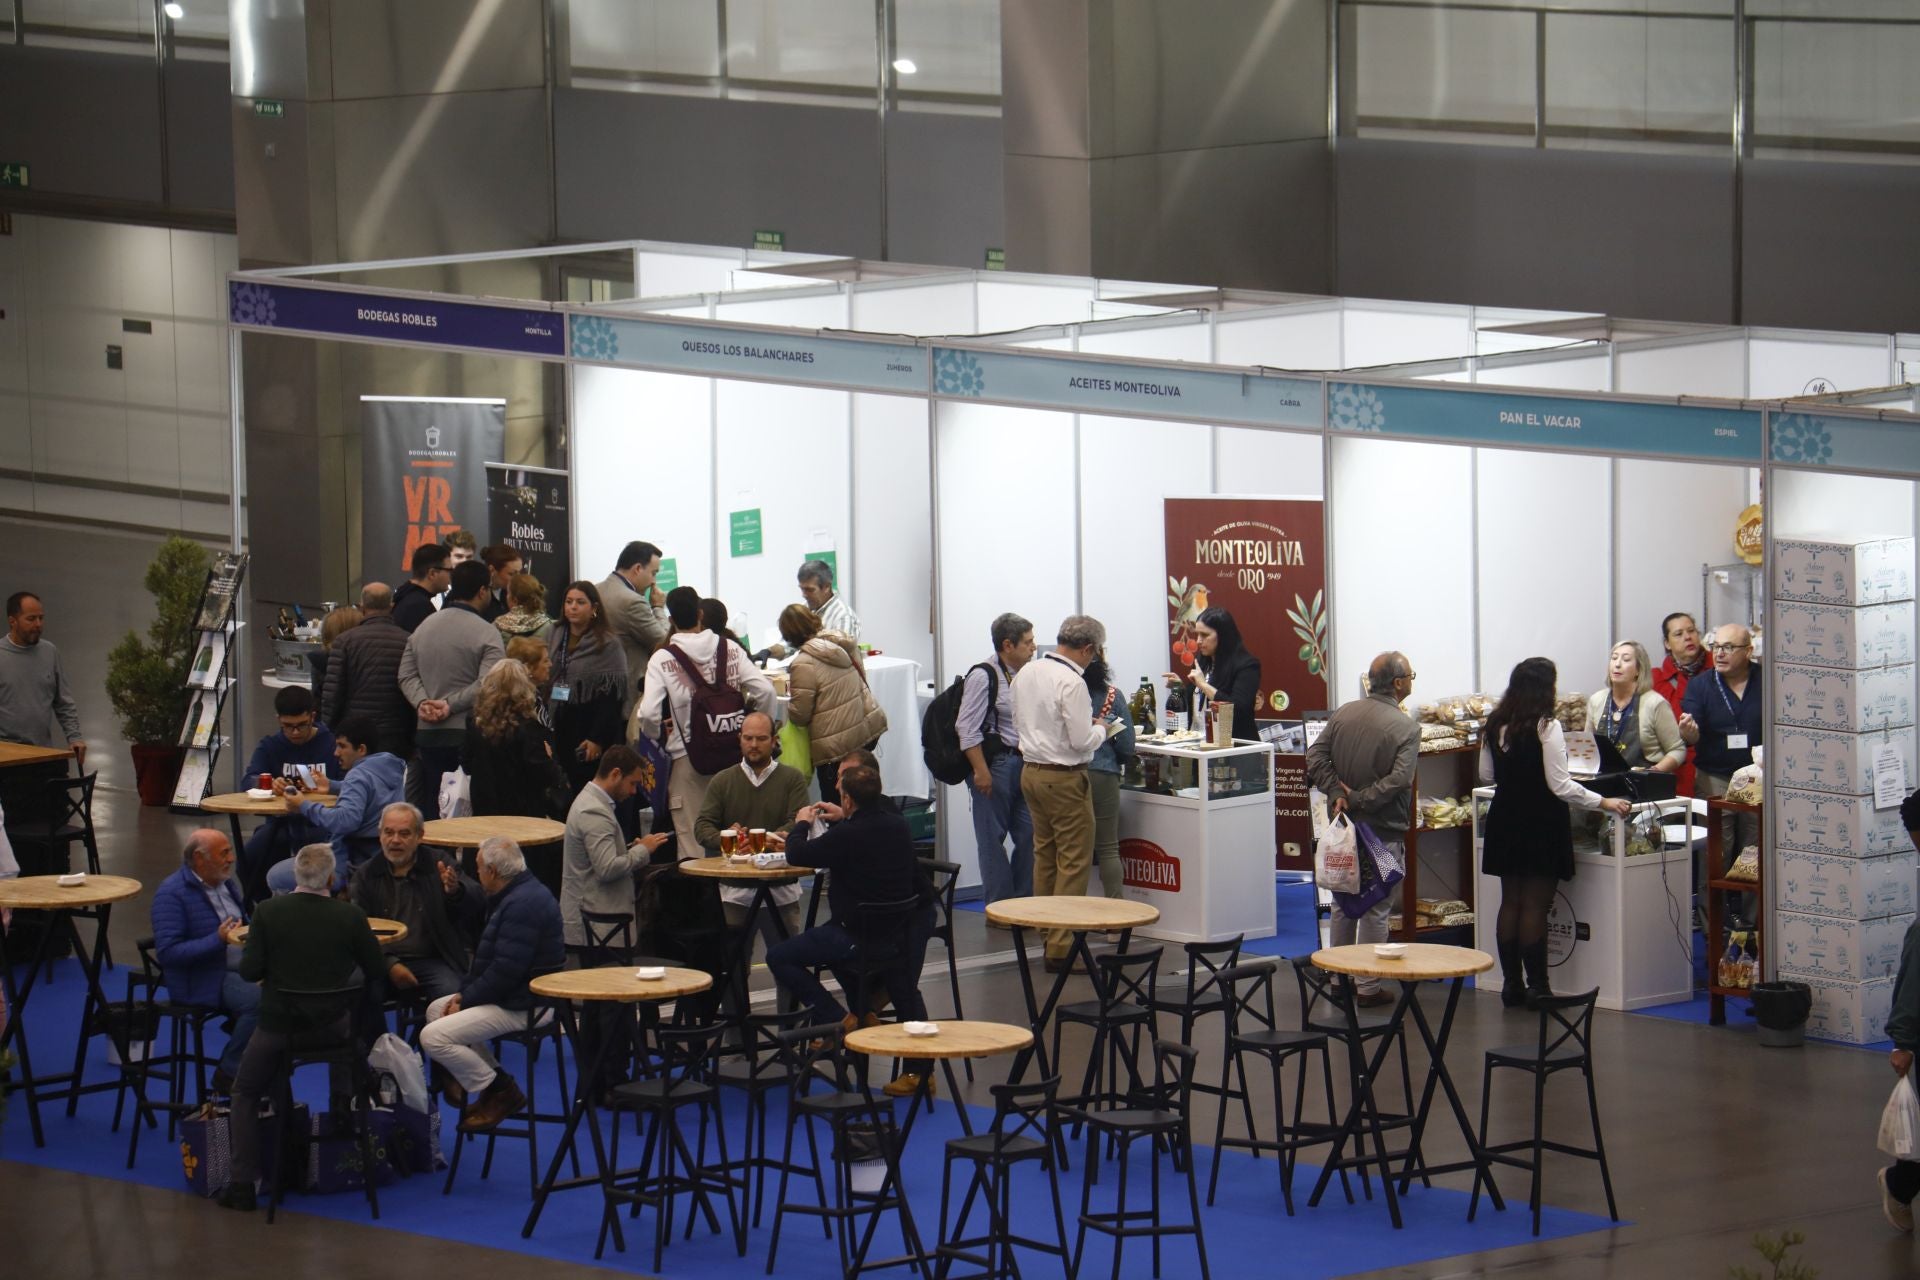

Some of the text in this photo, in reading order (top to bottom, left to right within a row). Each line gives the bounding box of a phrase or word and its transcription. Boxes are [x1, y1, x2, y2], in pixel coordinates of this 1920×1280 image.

[358, 308, 437, 327] BODEGAS ROBLES
[525, 327, 552, 336] MONTILLA
[682, 340, 814, 363] QUESOS LOS BALANCHARES
[886, 364, 912, 372] ZUHEROS
[1069, 377, 1180, 397] ACEITES MONTEOLIVA
[1280, 399, 1300, 407] CABRA
[1500, 412, 1581, 428] PAN EL VACAR
[1714, 428, 1738, 438] ESPIEL
[402, 475, 454, 523] VR
[512, 521, 544, 540] Robles
[1238, 568, 1264, 594] ORO
[706, 709, 745, 732] VANS
